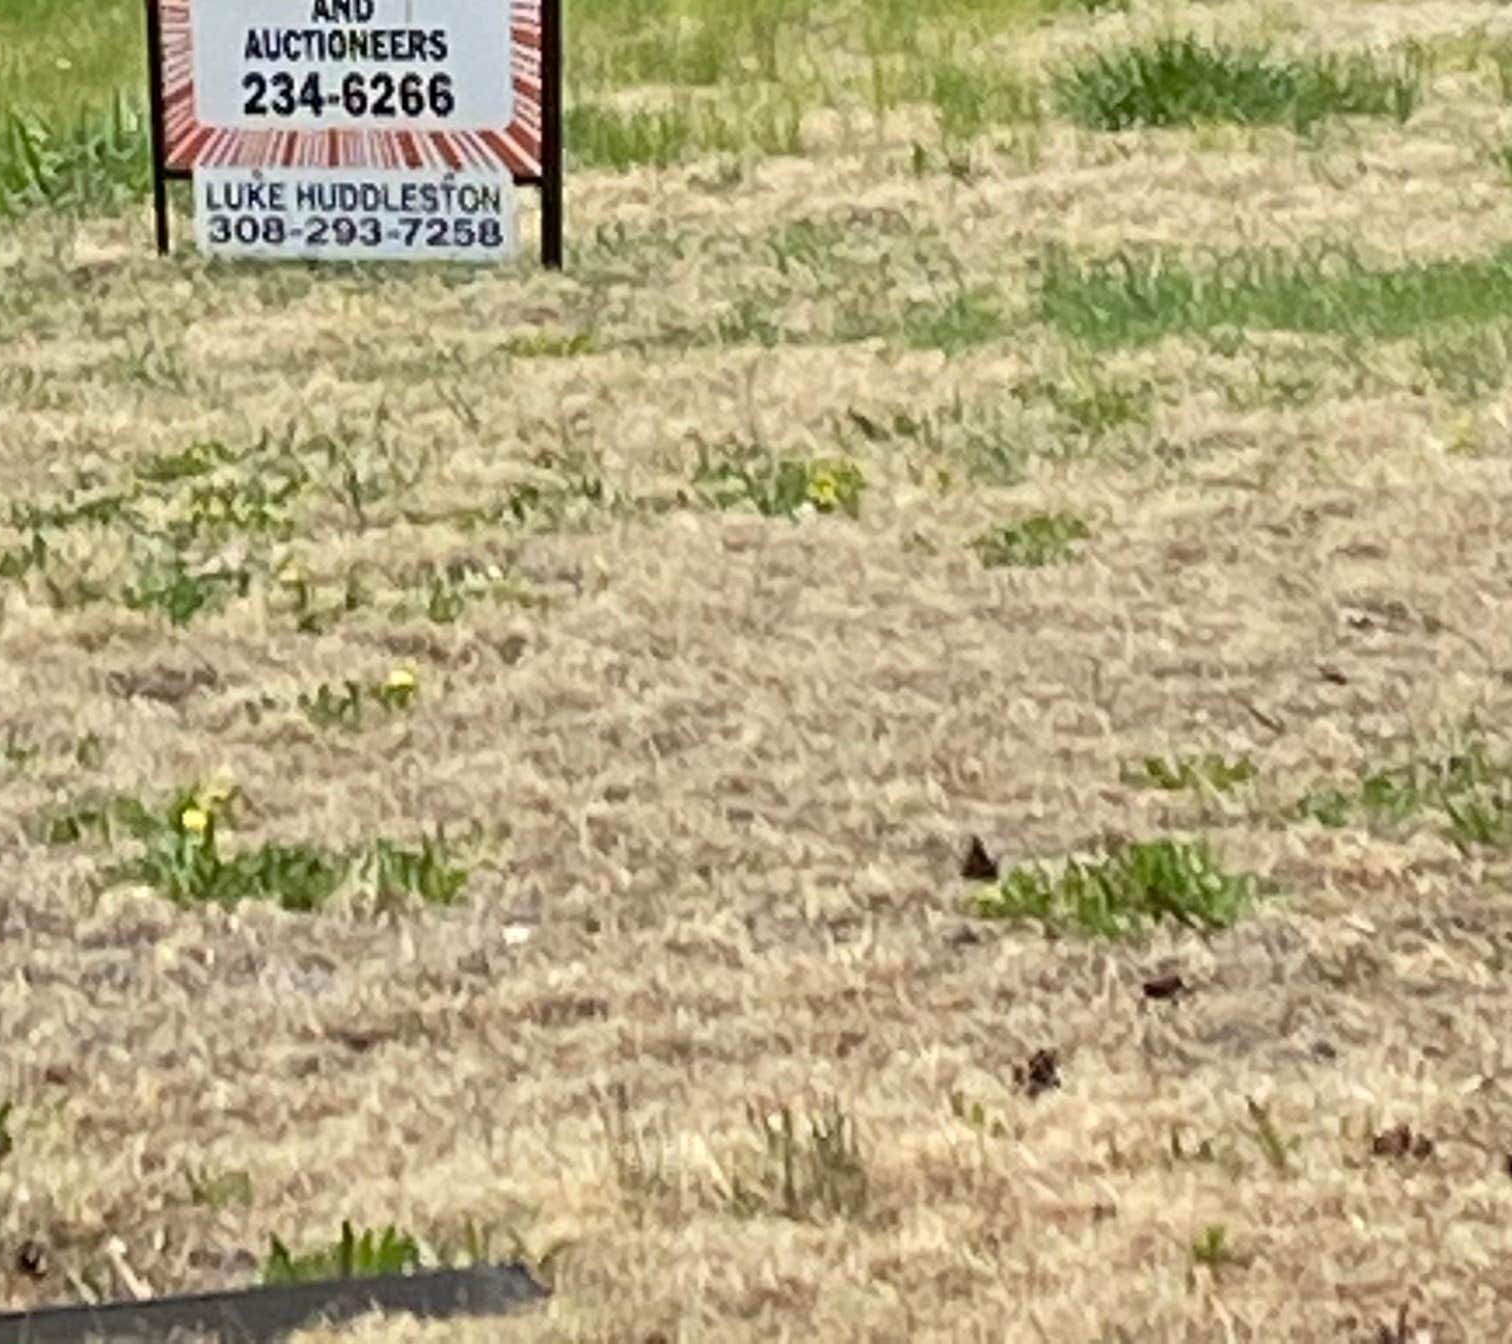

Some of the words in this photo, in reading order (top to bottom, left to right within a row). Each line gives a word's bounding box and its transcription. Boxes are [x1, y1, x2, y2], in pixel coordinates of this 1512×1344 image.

[244, 29, 449, 62] AUCTIONEERS
[241, 72, 456, 117] 234-6266
[205, 182, 288, 211] LUKE
[295, 182, 501, 213] HUDDLESTON
[207, 215, 505, 247] 308-293-7258
